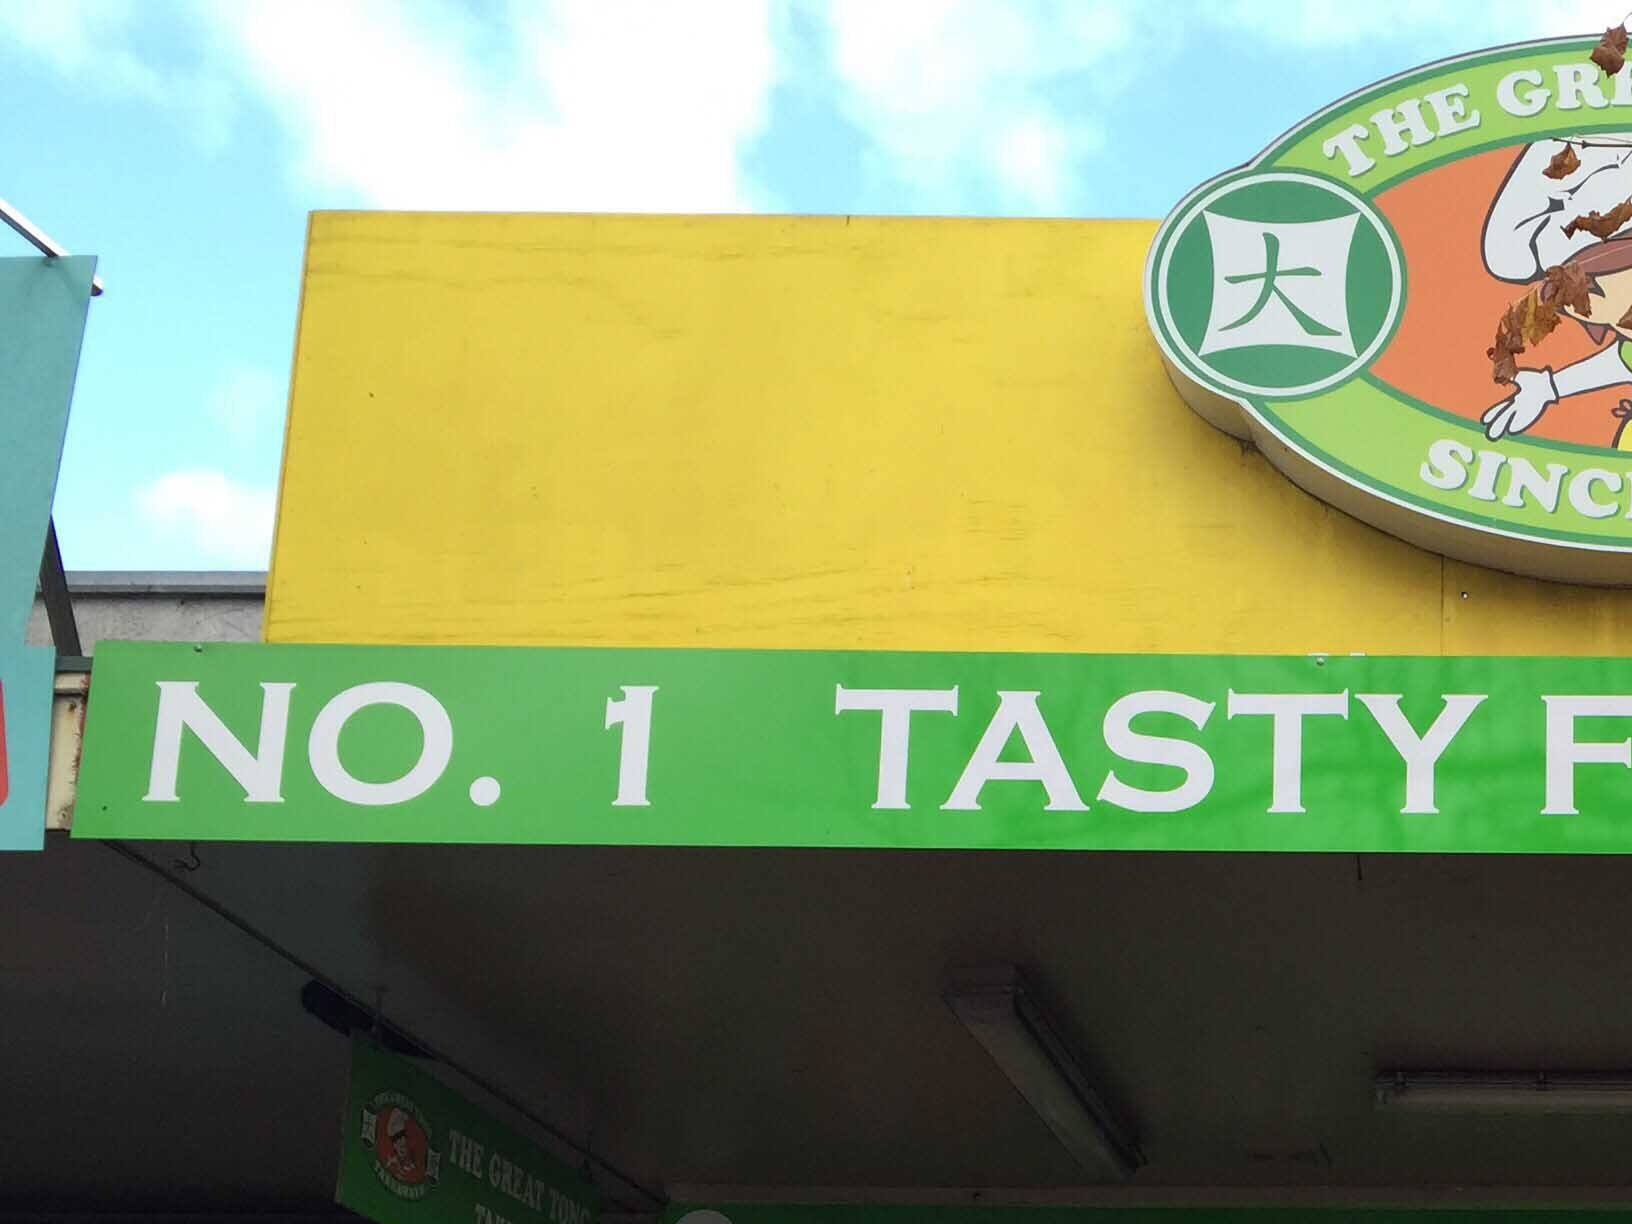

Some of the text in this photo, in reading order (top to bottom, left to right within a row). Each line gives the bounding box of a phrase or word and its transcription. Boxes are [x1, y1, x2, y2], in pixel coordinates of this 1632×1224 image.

[1322, 82, 1481, 177] THE
[1217, 232, 1343, 337] 大
[142, 680, 501, 807] NO.
[605, 685, 659, 808] 1
[834, 683, 1489, 815] TASTY
